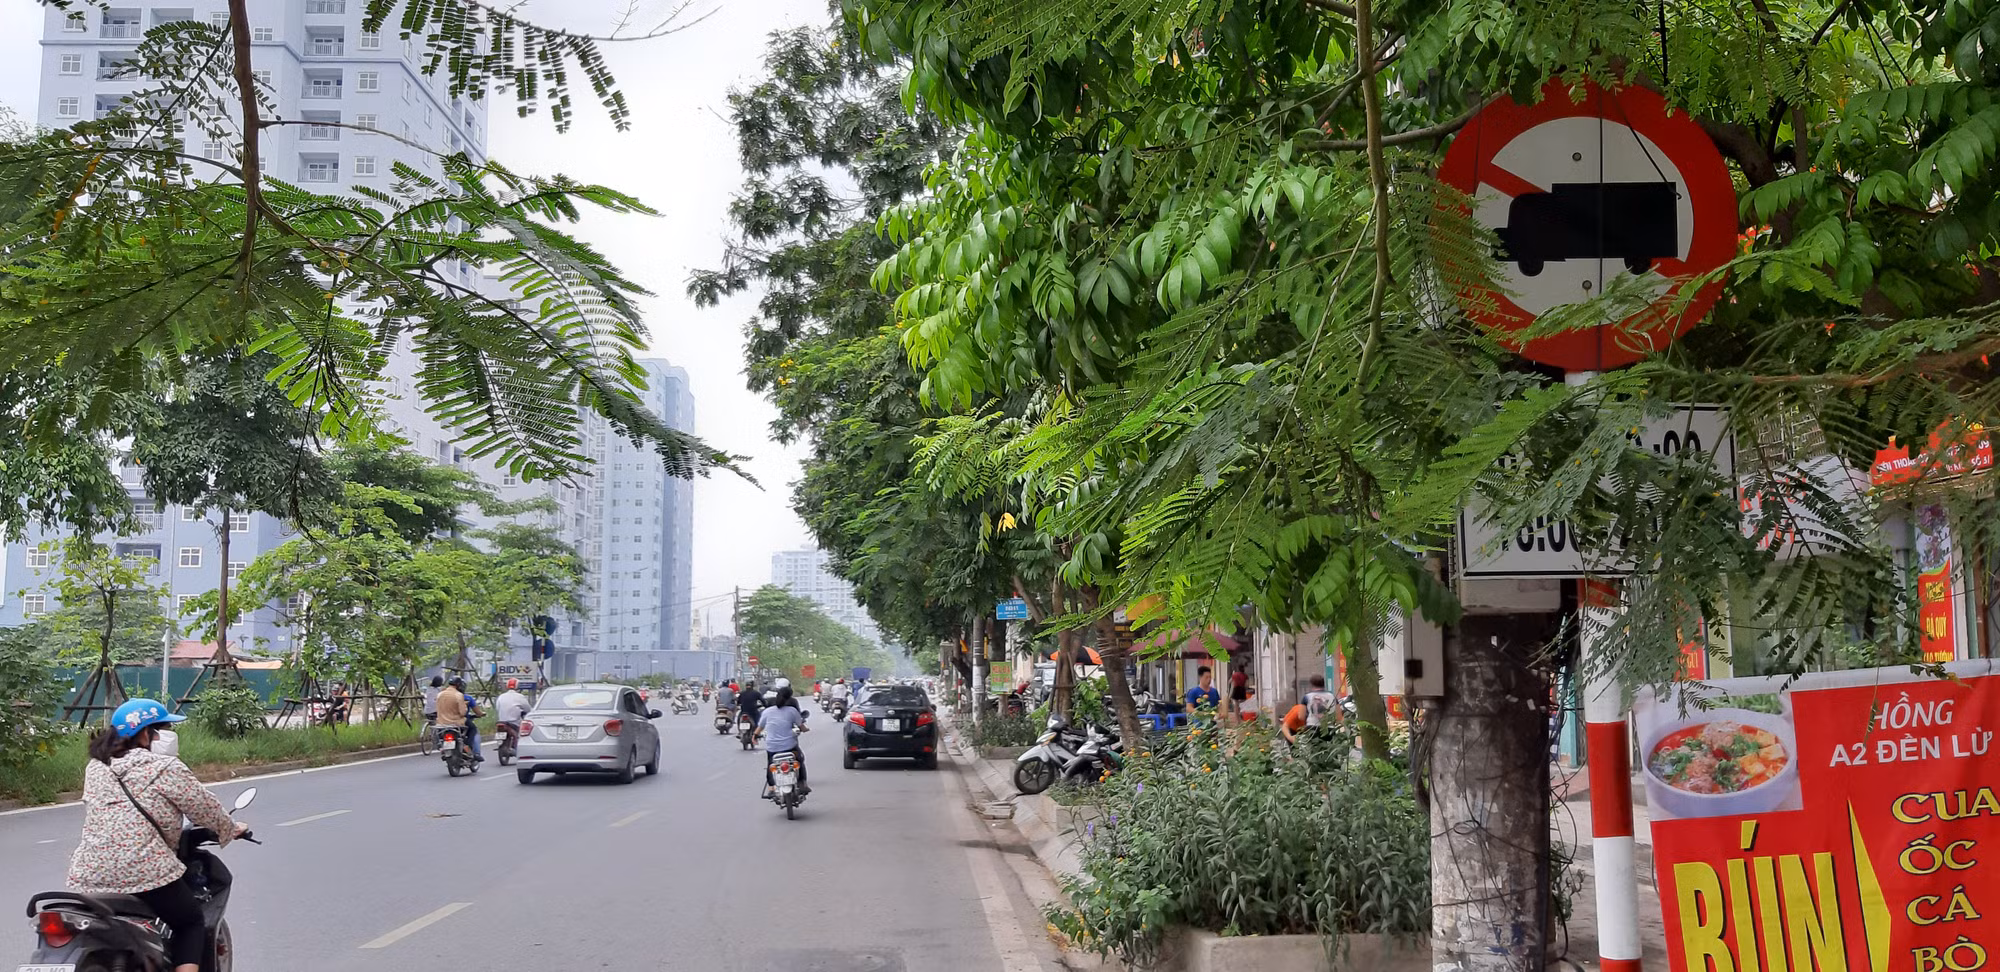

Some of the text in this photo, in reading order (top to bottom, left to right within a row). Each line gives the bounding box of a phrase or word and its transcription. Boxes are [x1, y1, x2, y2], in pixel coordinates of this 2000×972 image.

[1874, 691, 1954, 730] HỒNG
[1829, 726, 1993, 767] A2 ĐỀN LỪ
[1891, 787, 2000, 824] CUA
[1898, 833, 1977, 875] ỐC
[1673, 819, 1850, 972] BÚN
[1906, 885, 1981, 926] CÁ
[1911, 935, 1987, 972] BÒ
